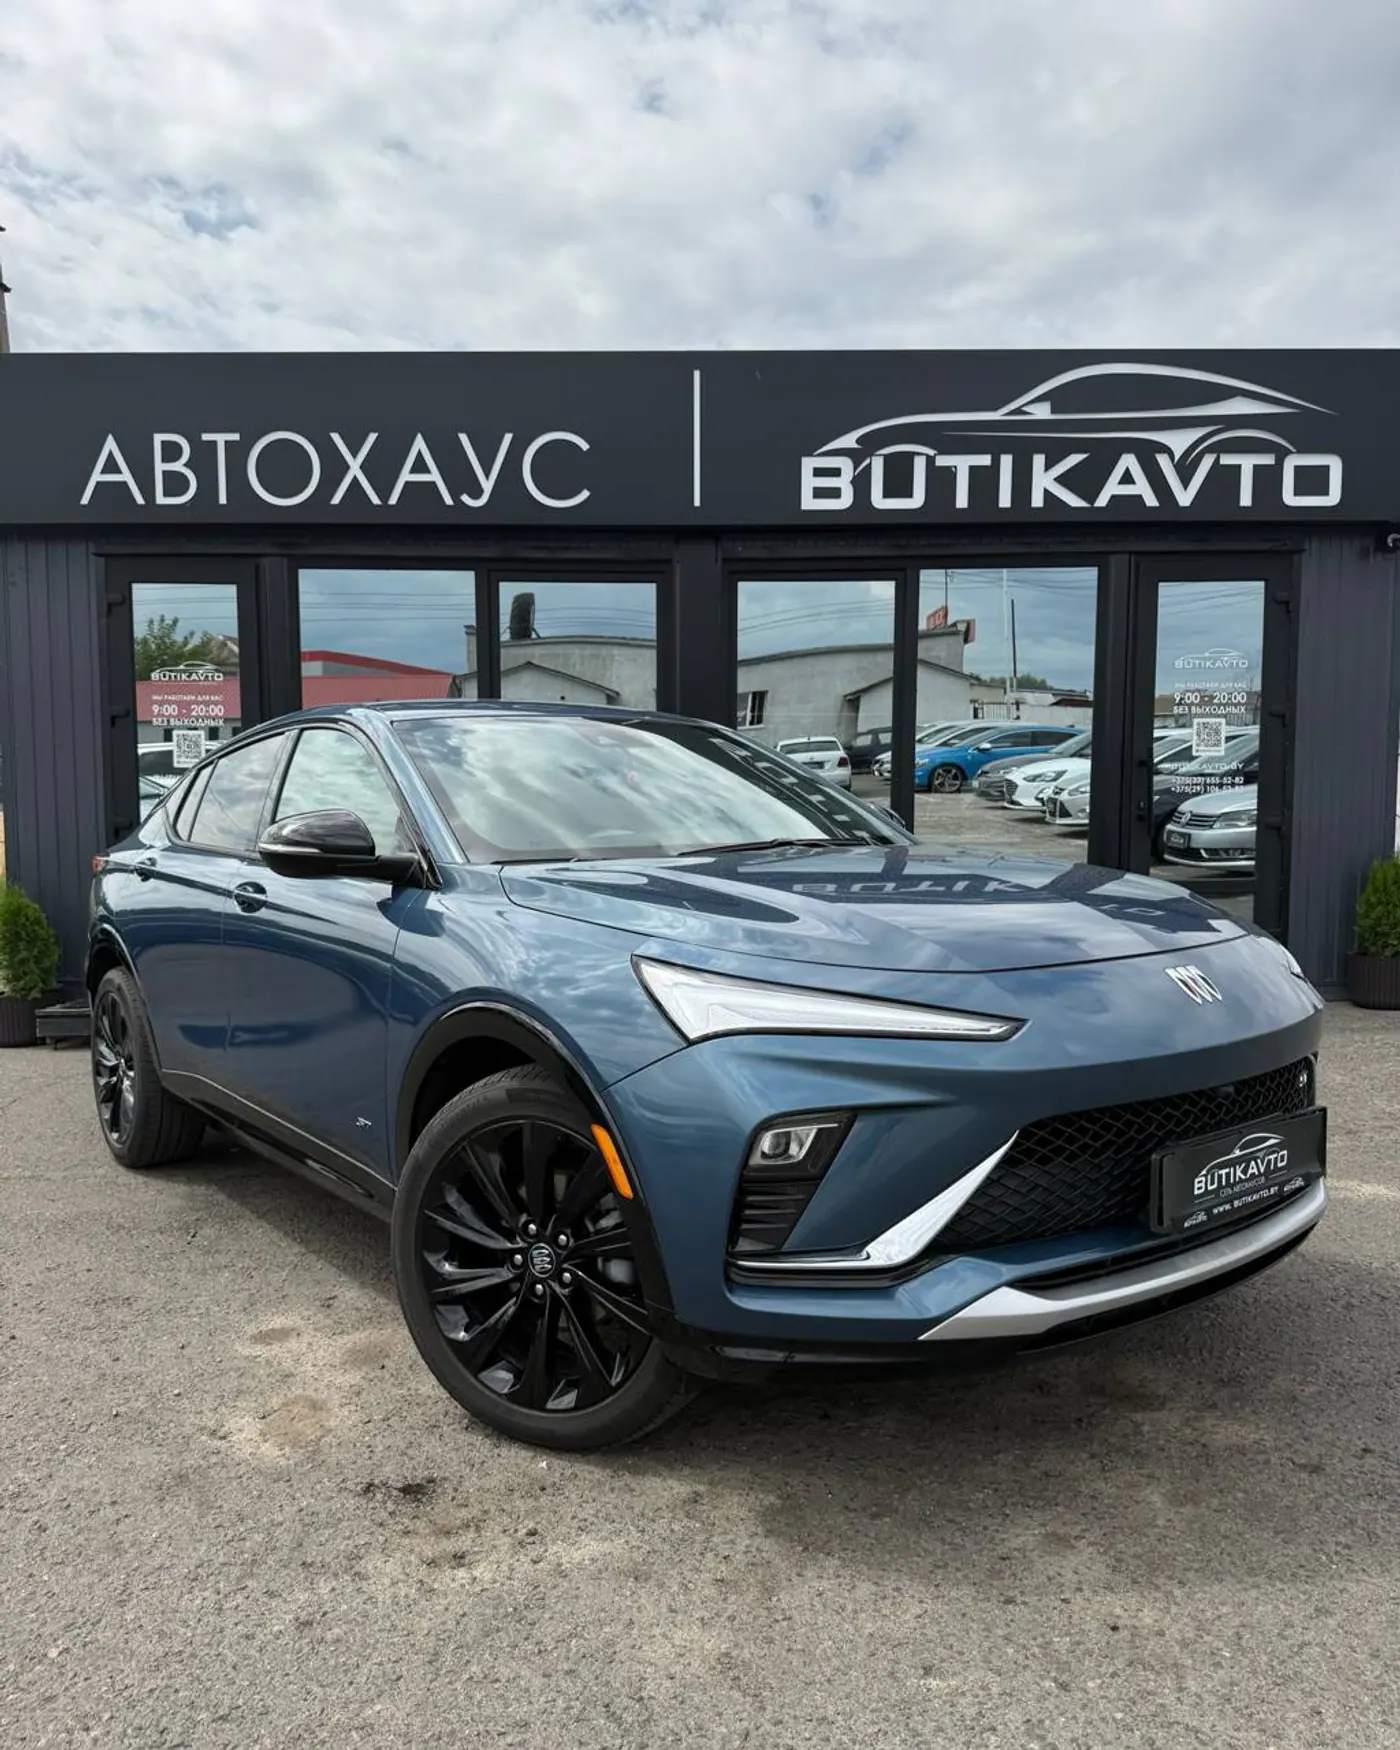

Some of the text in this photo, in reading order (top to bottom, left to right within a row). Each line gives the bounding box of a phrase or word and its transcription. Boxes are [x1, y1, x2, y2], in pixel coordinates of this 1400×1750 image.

[80, 431, 591, 509] АВТОХАУС
[801, 453, 1342, 511] BUTIKAVTO
[1174, 659, 1248, 669] BUTIKAVTO
[151, 672, 224, 681] BUTIKAVTO
[1174, 691, 1200, 704] 9:00
[1213, 691, 1247, 704] 20:00
[152, 704, 178, 716] 9:00
[191, 704, 224, 716] 20:00
[1173, 705, 1246, 715] БЕЗ ВЫХОДНЫХ
[152, 717, 224, 726] БЕЗ ВЫХОДНЫХ
[1193, 1150, 1288, 1195] BUTIKAVTO
